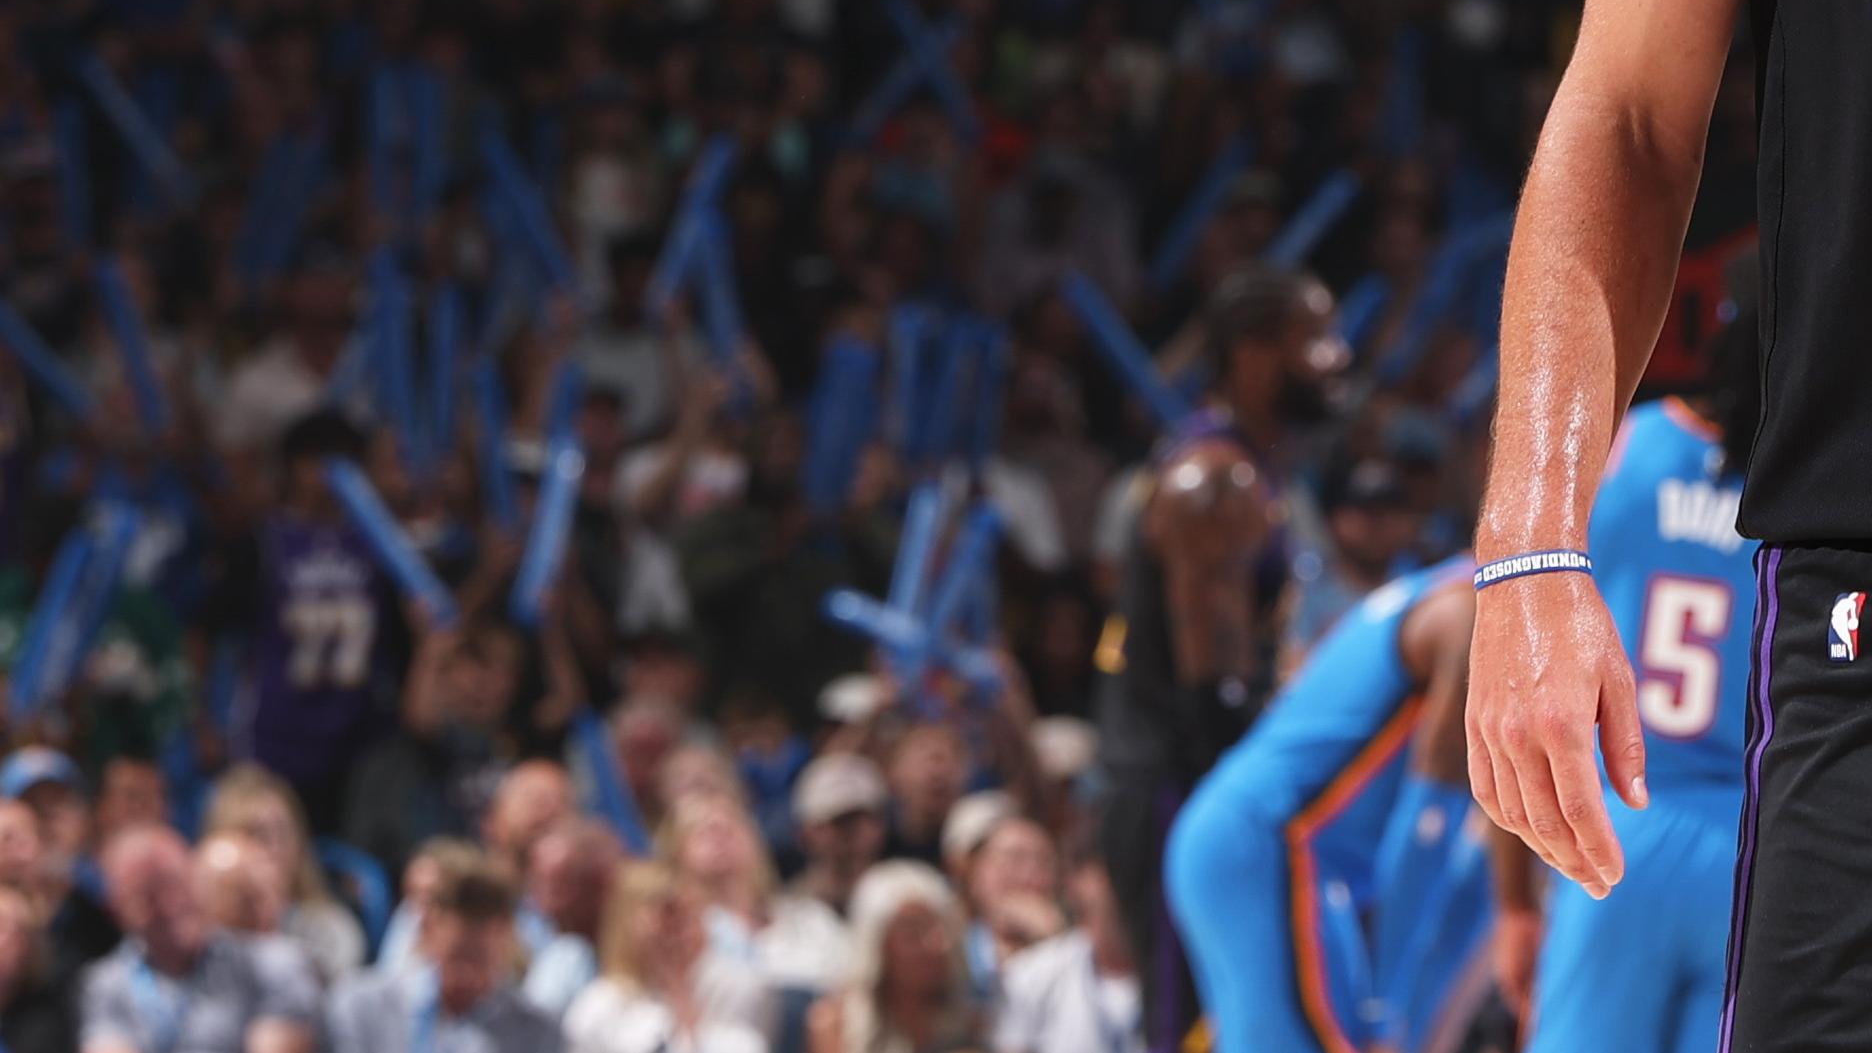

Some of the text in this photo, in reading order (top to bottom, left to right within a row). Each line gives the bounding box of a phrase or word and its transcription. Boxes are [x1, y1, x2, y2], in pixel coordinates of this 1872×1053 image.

[1482, 552, 1580, 582] UNDIAGNOSED
[1638, 571, 1734, 741] 5
[1831, 643, 1847, 659] NBA
